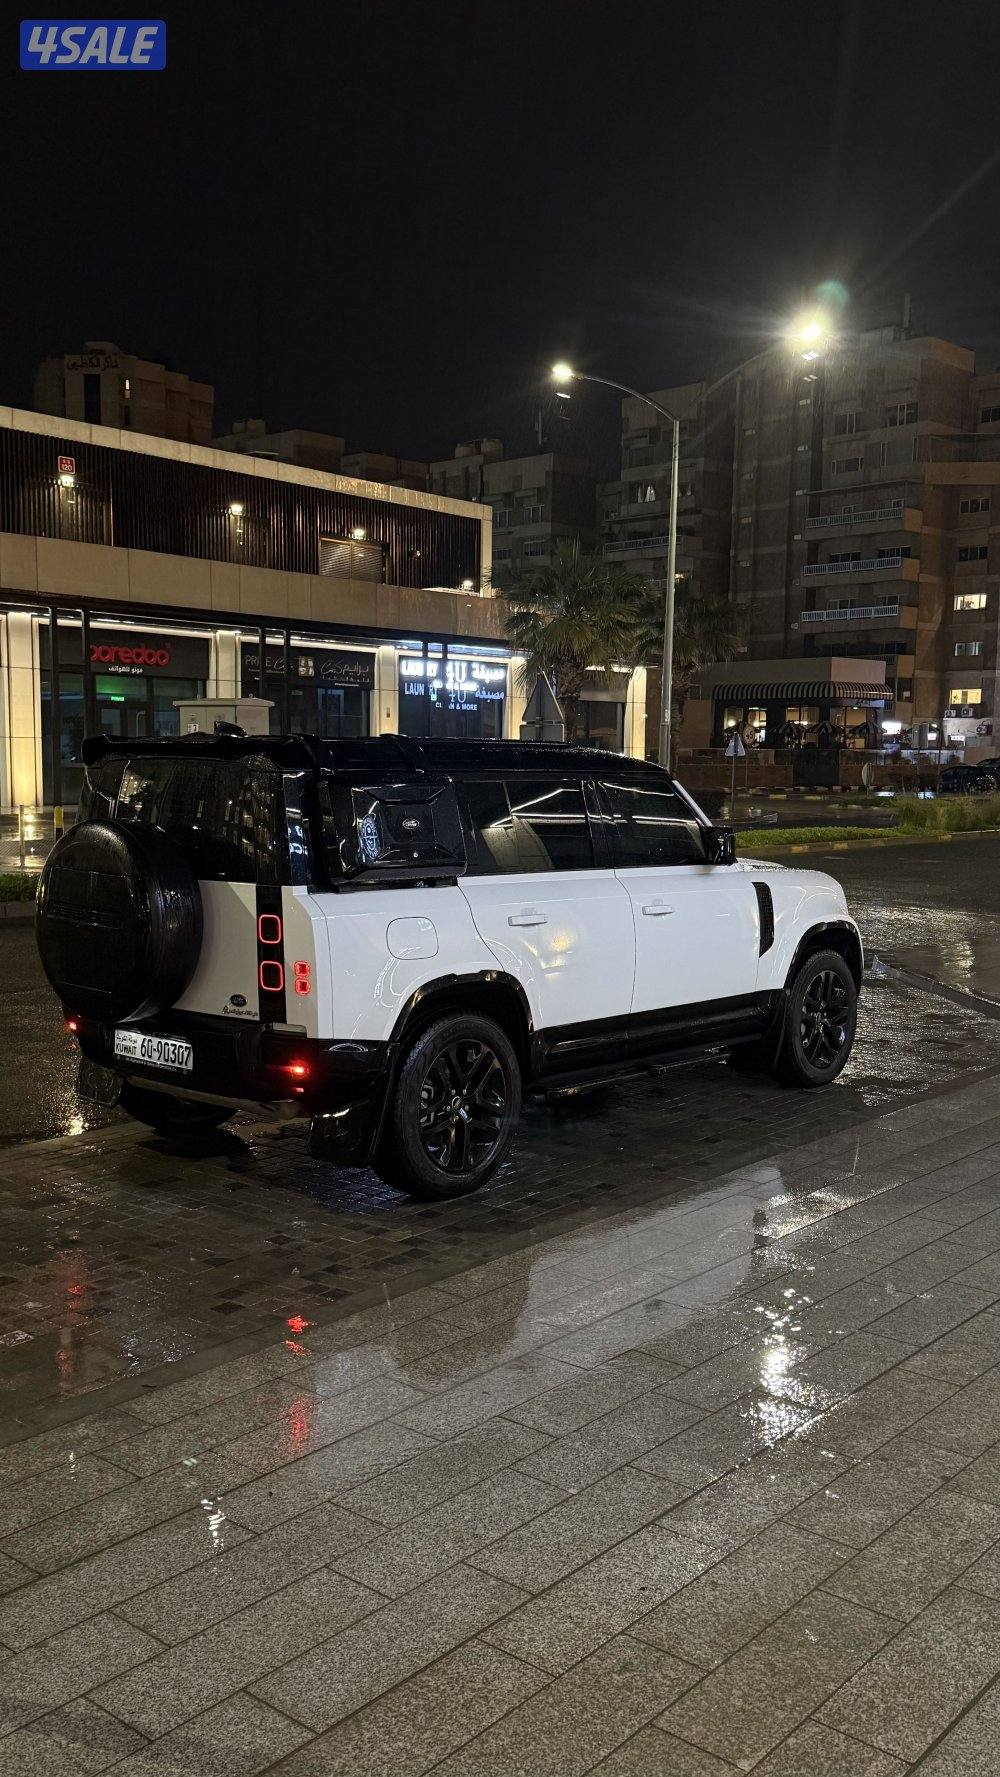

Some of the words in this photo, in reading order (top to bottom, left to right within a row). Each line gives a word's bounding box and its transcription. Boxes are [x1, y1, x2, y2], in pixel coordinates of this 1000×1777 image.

[245, 654, 272, 667] PRIE
[115, 1043, 137, 1056] KUWAIT
[140, 1037, 192, 1066] 60-90307
